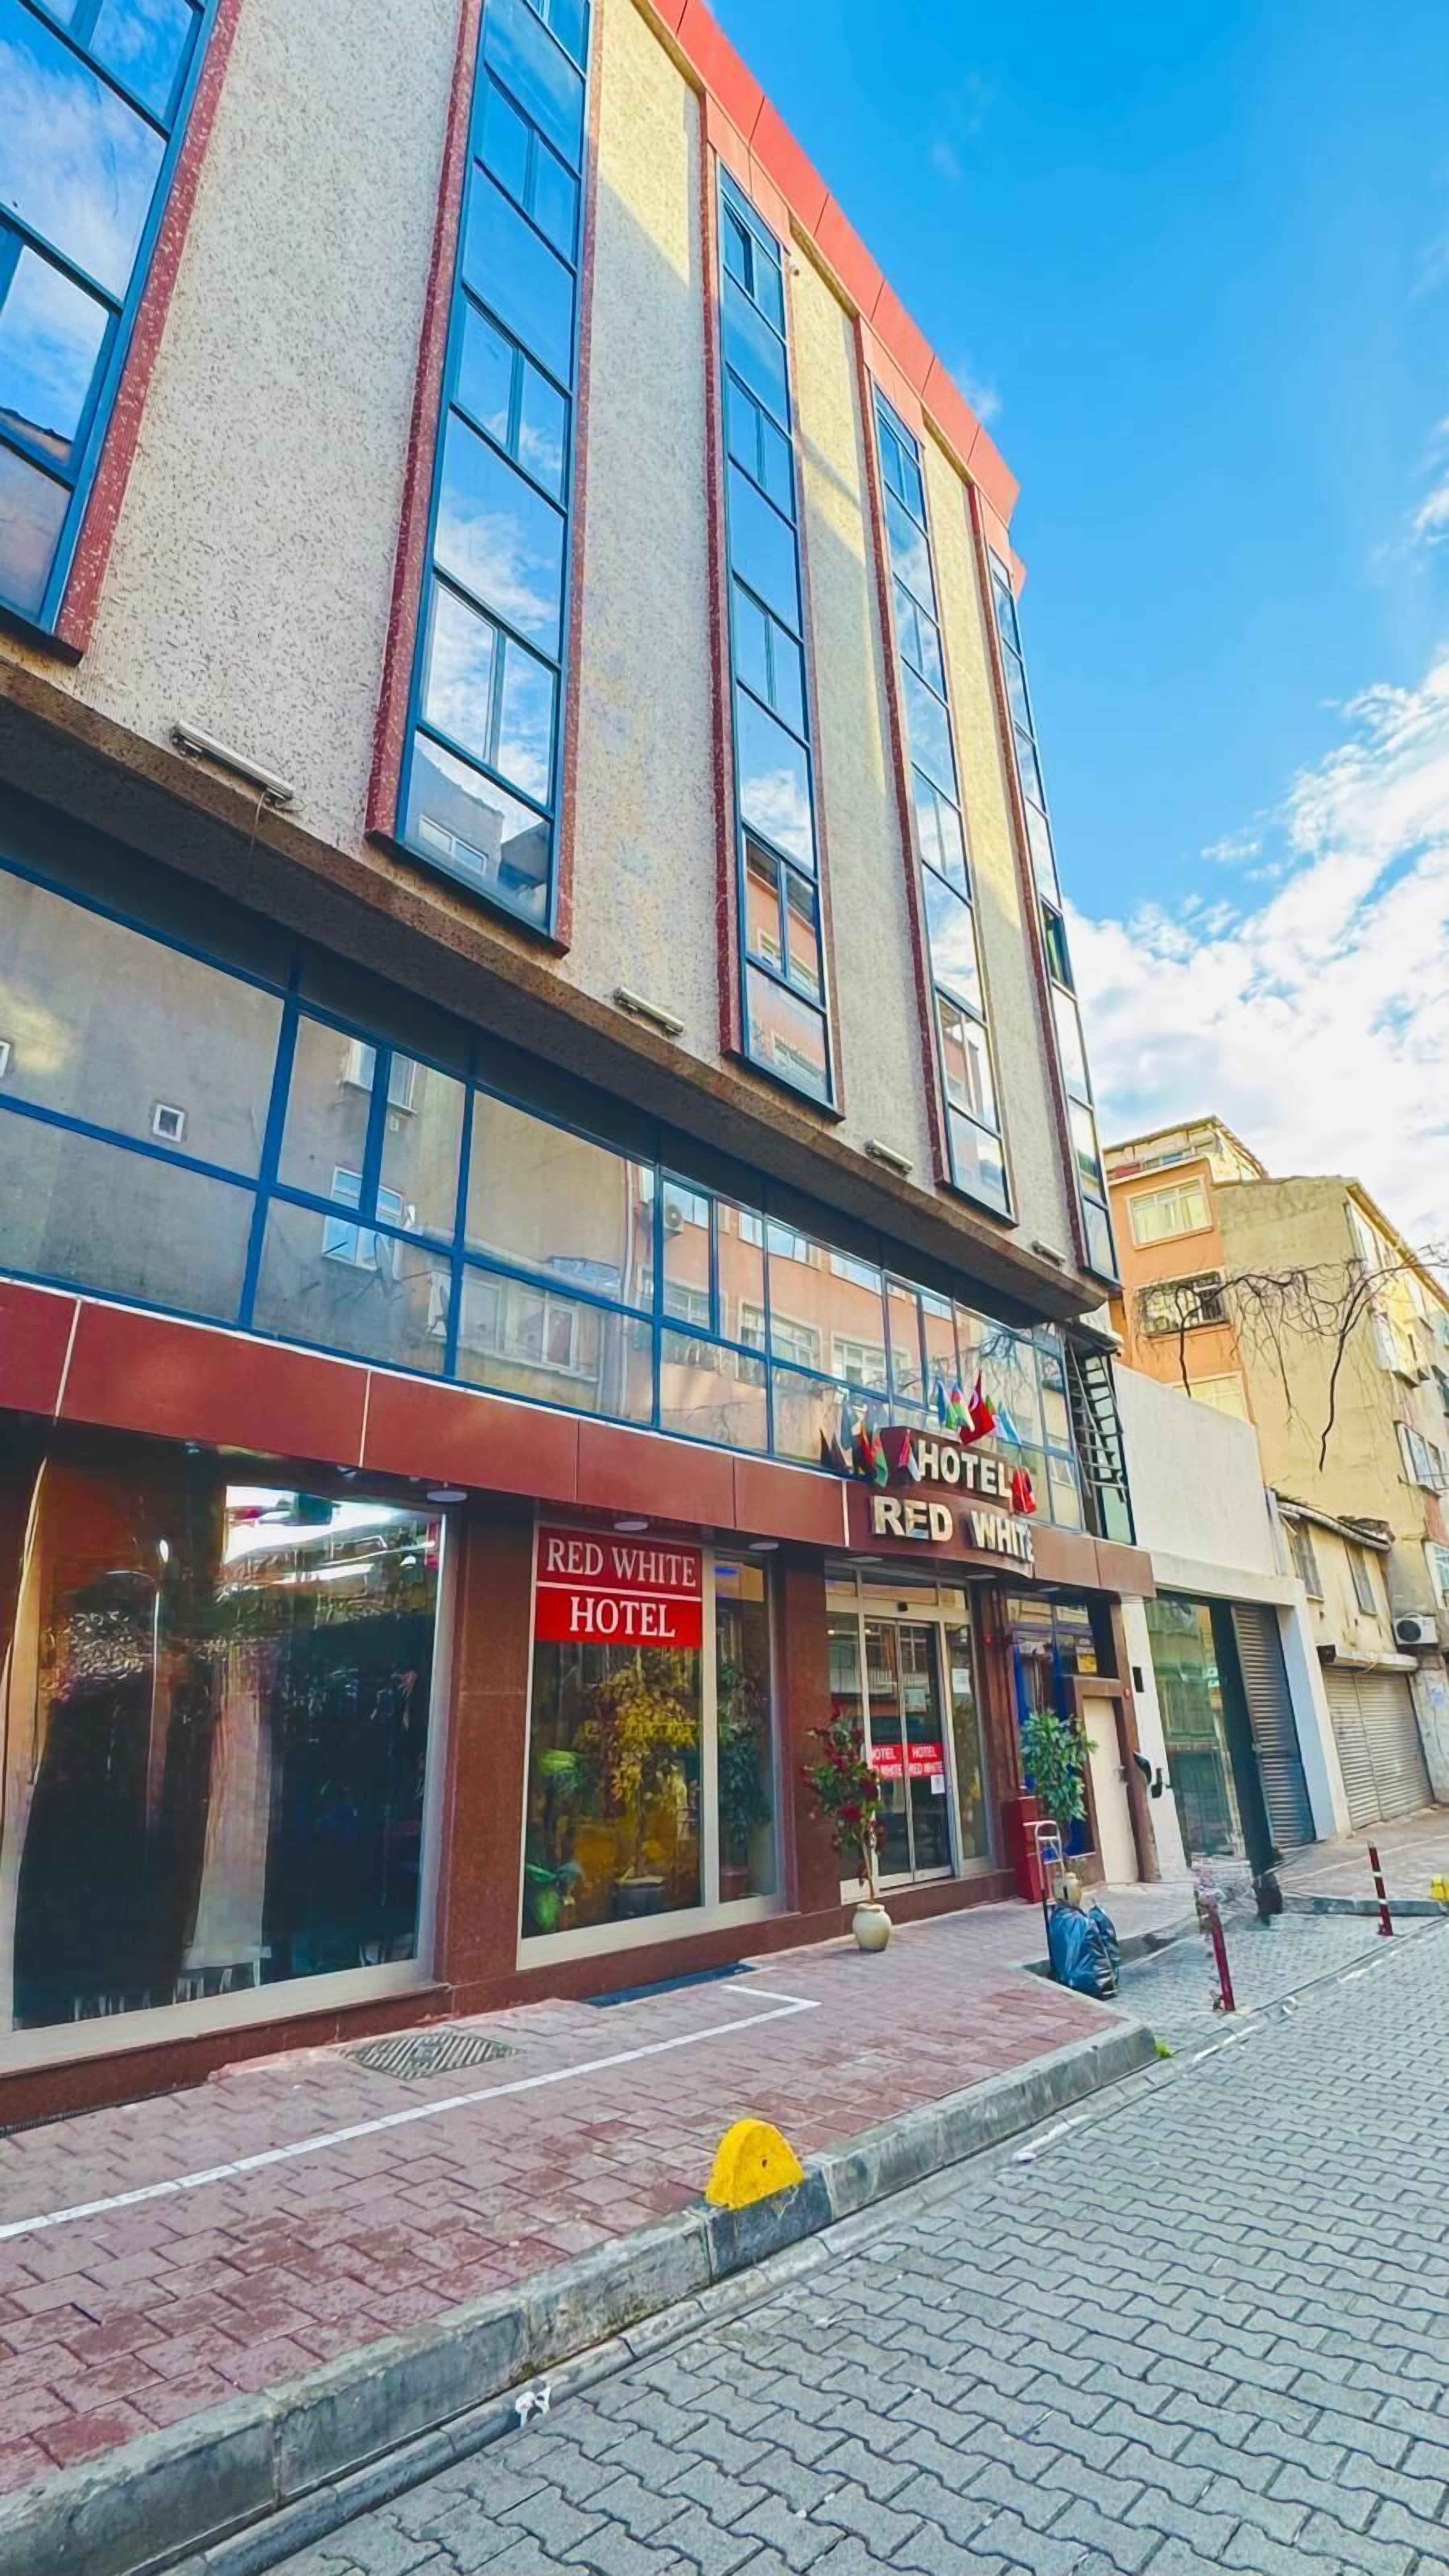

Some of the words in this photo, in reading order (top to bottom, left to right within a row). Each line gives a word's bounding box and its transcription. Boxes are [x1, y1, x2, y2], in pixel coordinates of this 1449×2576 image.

[917, 1439, 1012, 1498] HOTEL
[874, 1496, 953, 1541] RED
[547, 1538, 603, 1575] RED
[611, 1546, 696, 1587] WHITE
[570, 1596, 675, 1637] HOTEL
[873, 1748, 896, 1760] OTEL
